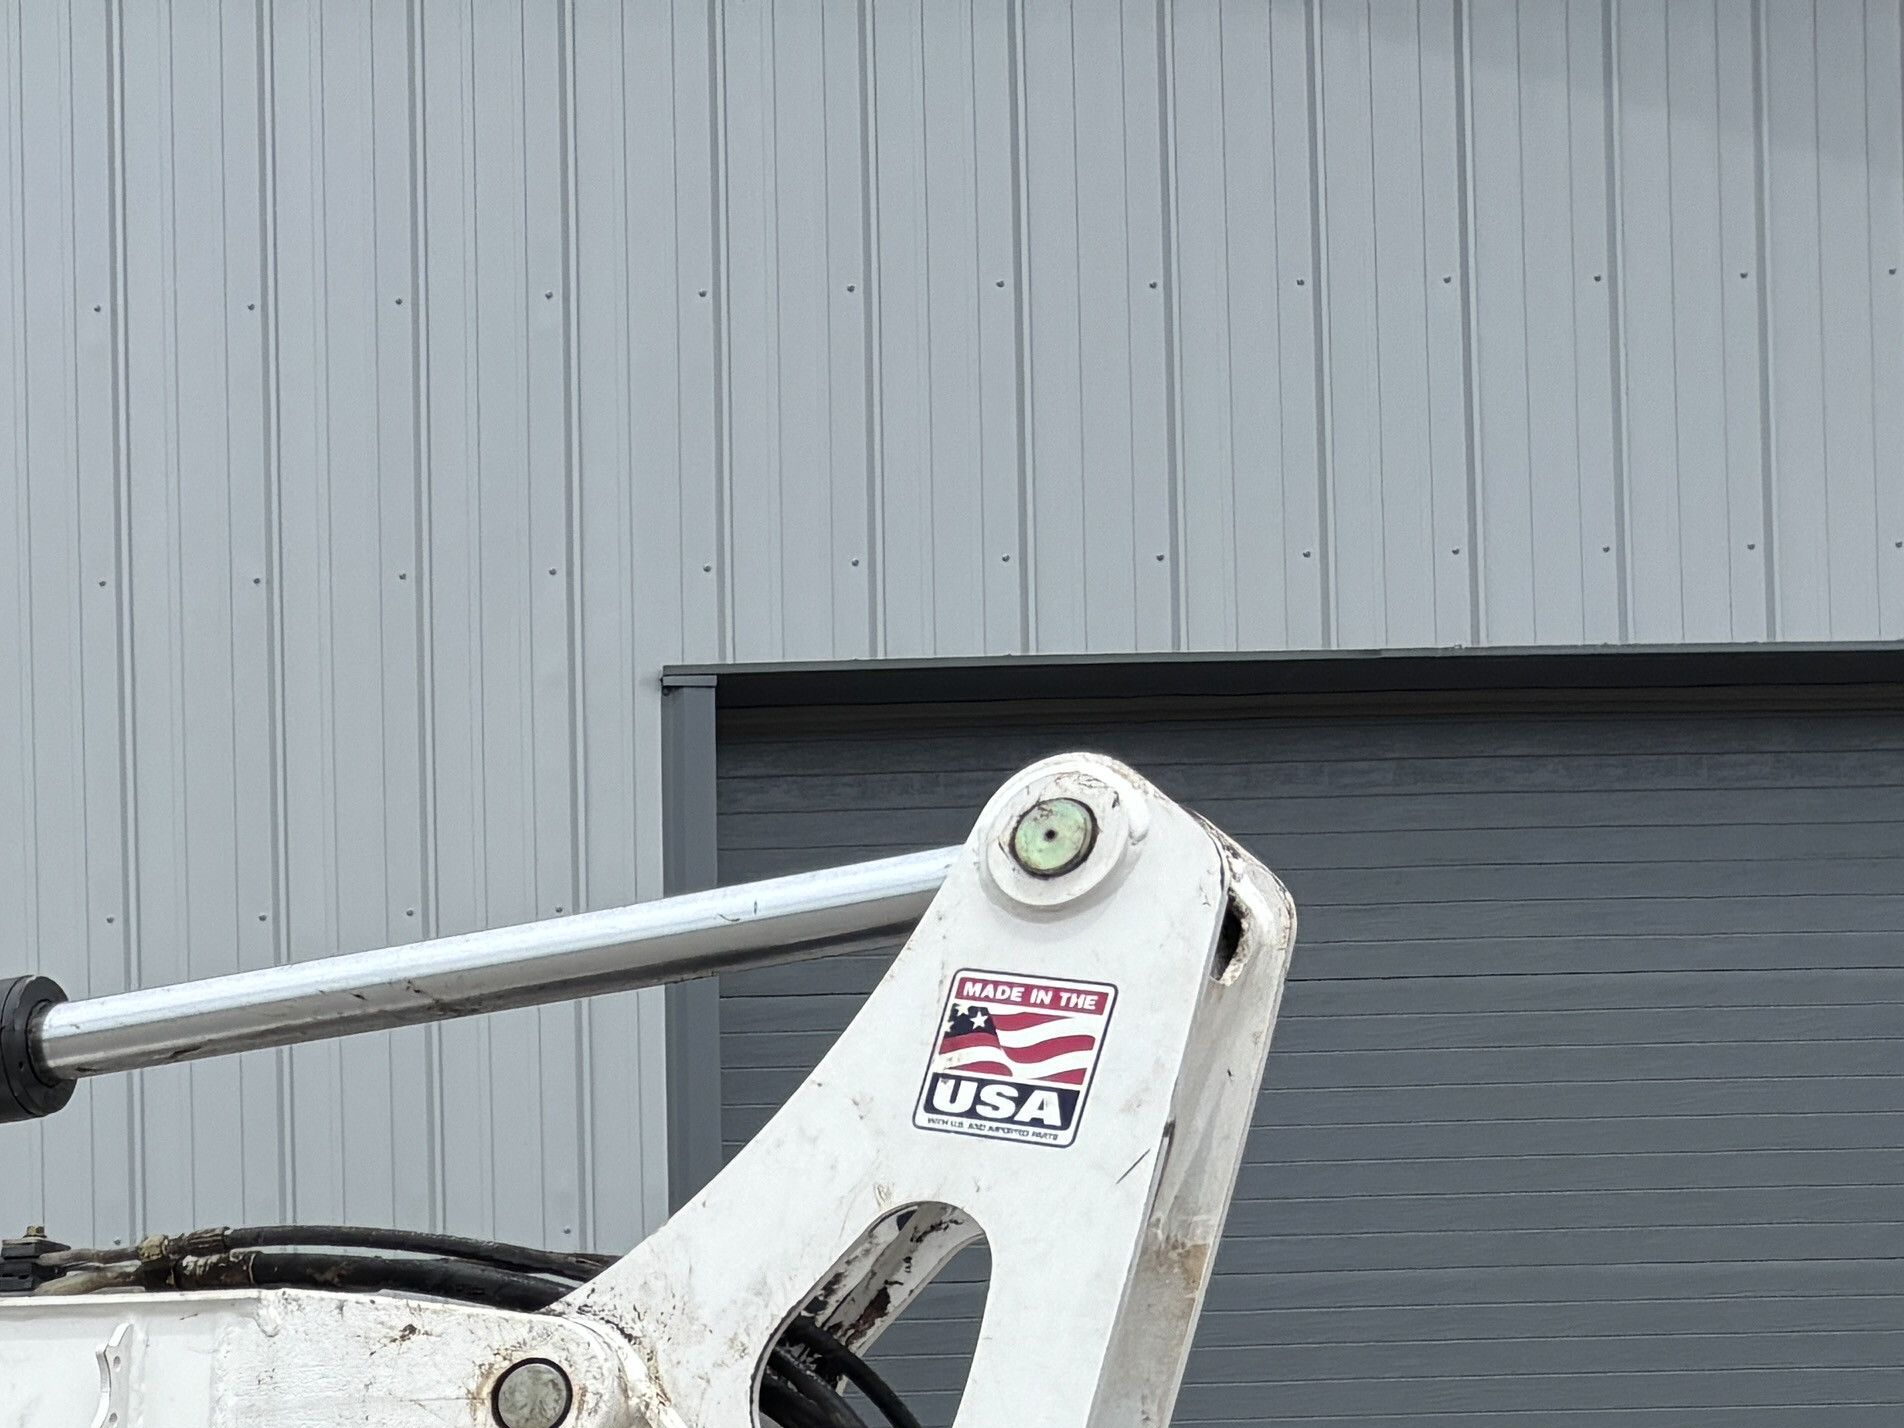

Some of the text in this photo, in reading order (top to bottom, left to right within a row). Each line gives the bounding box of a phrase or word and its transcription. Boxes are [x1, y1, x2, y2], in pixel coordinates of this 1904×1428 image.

[963, 982, 1099, 1010] MADE IN THE
[932, 1077, 1062, 1127] USA
